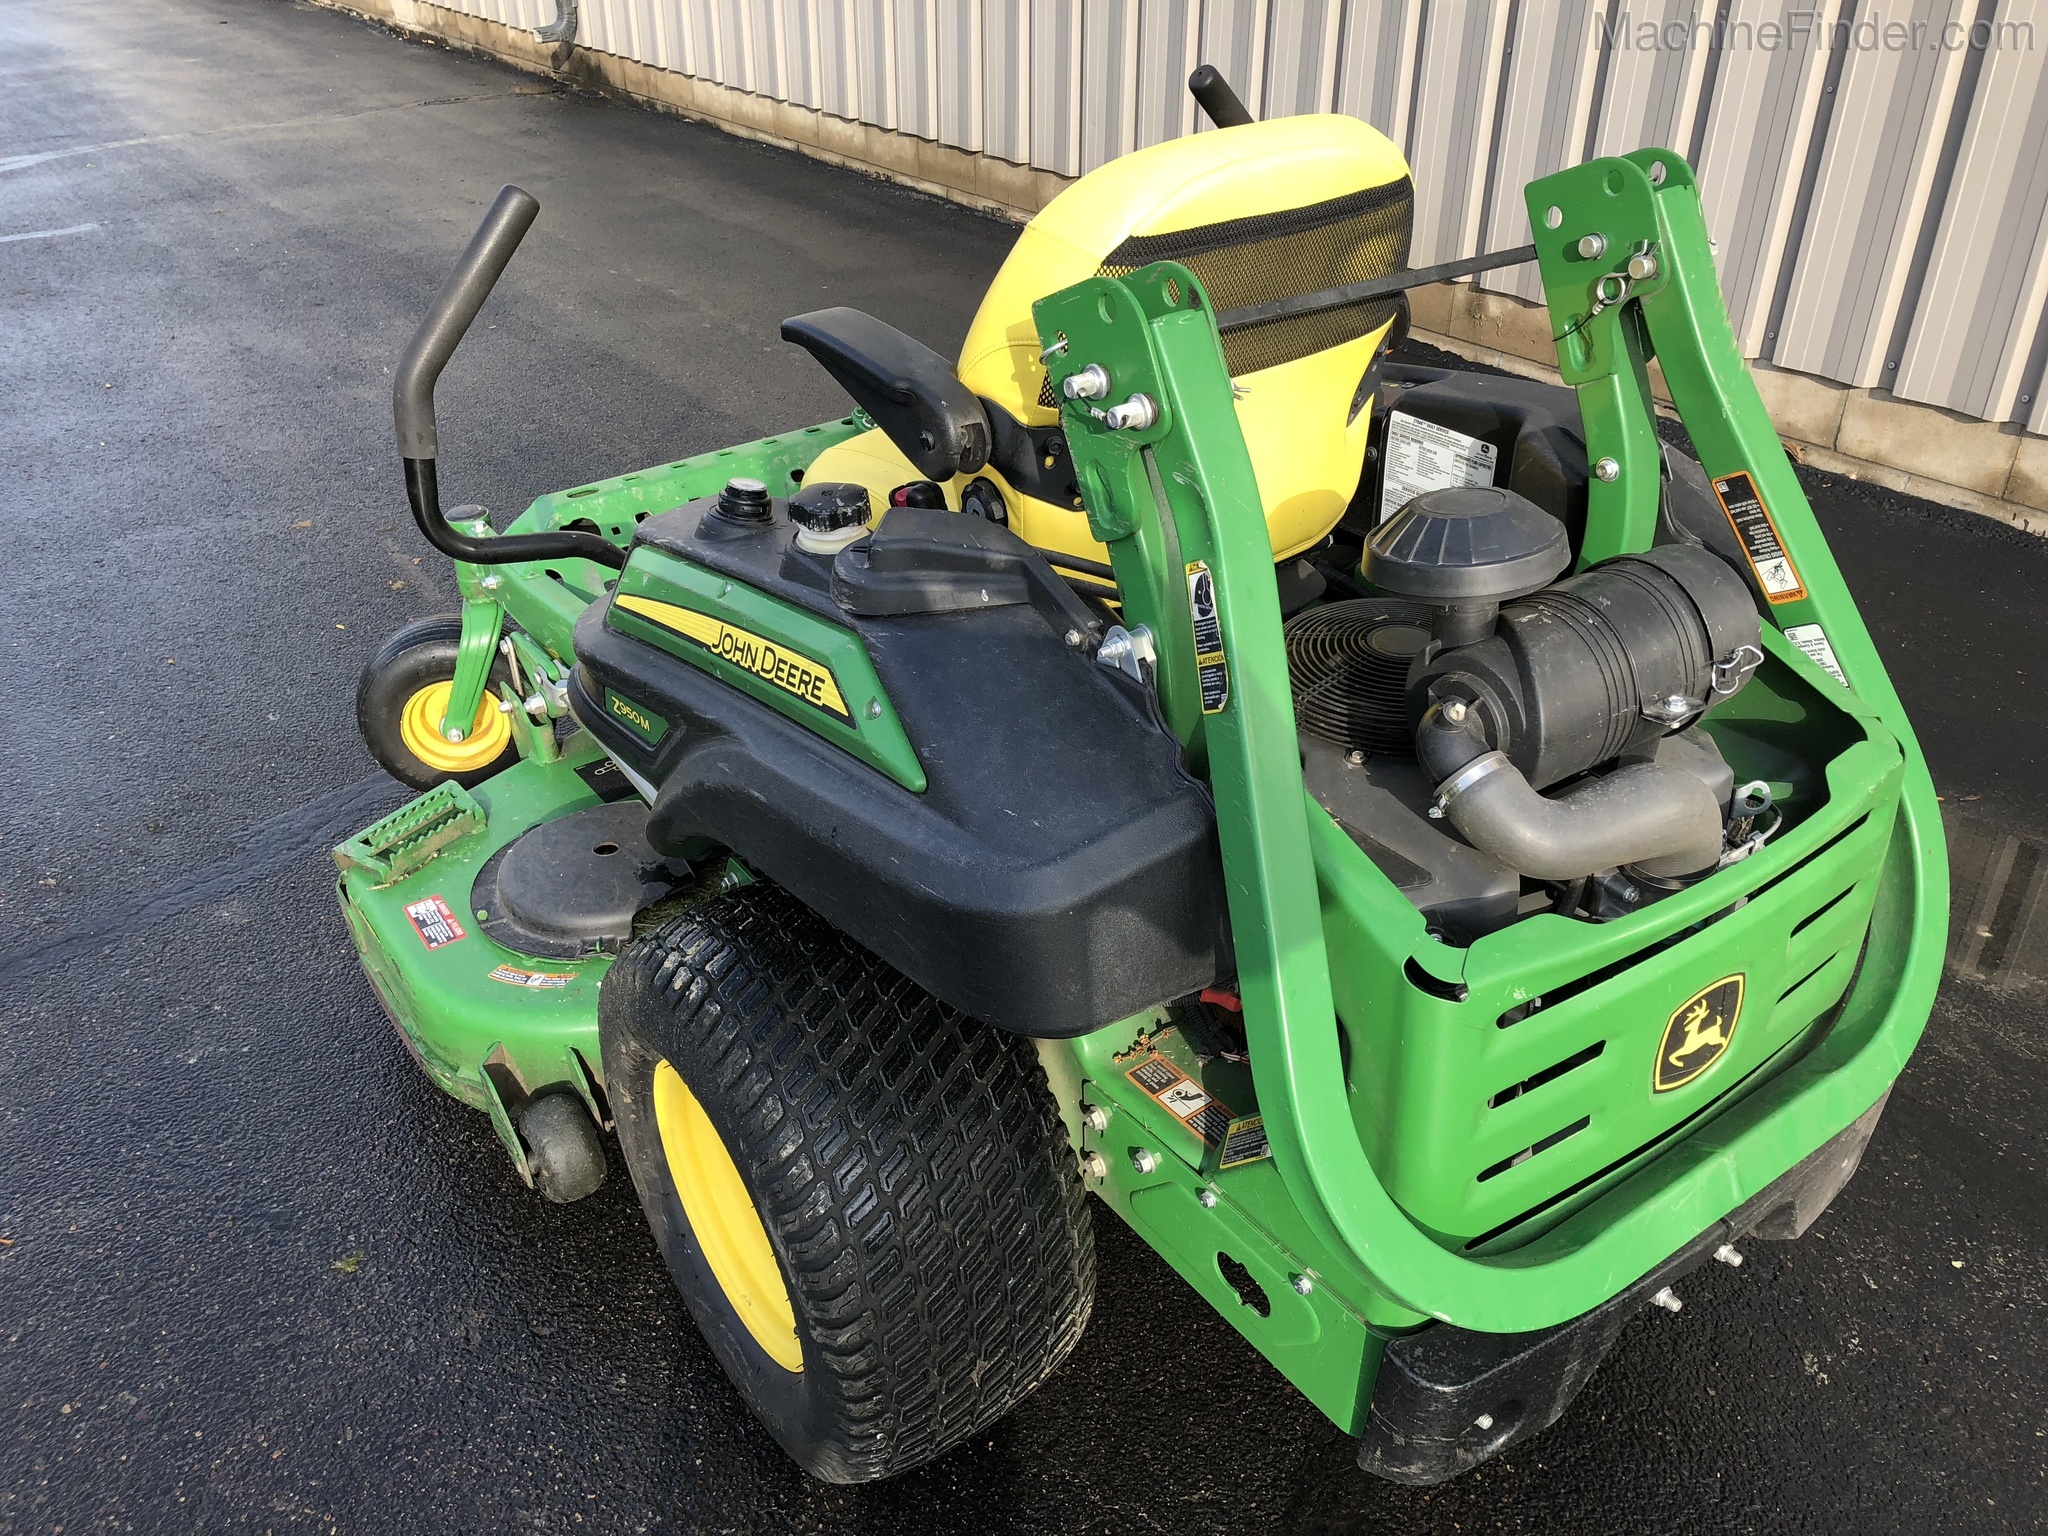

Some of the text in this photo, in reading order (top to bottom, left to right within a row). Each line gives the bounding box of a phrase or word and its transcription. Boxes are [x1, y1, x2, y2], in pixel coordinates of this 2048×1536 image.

[1769, 591, 1799, 602] WARNING
[711, 625, 826, 701] JOHN DEERE
[611, 696, 650, 732] Z950M
[1241, 1118, 1262, 1129] ATENCI
